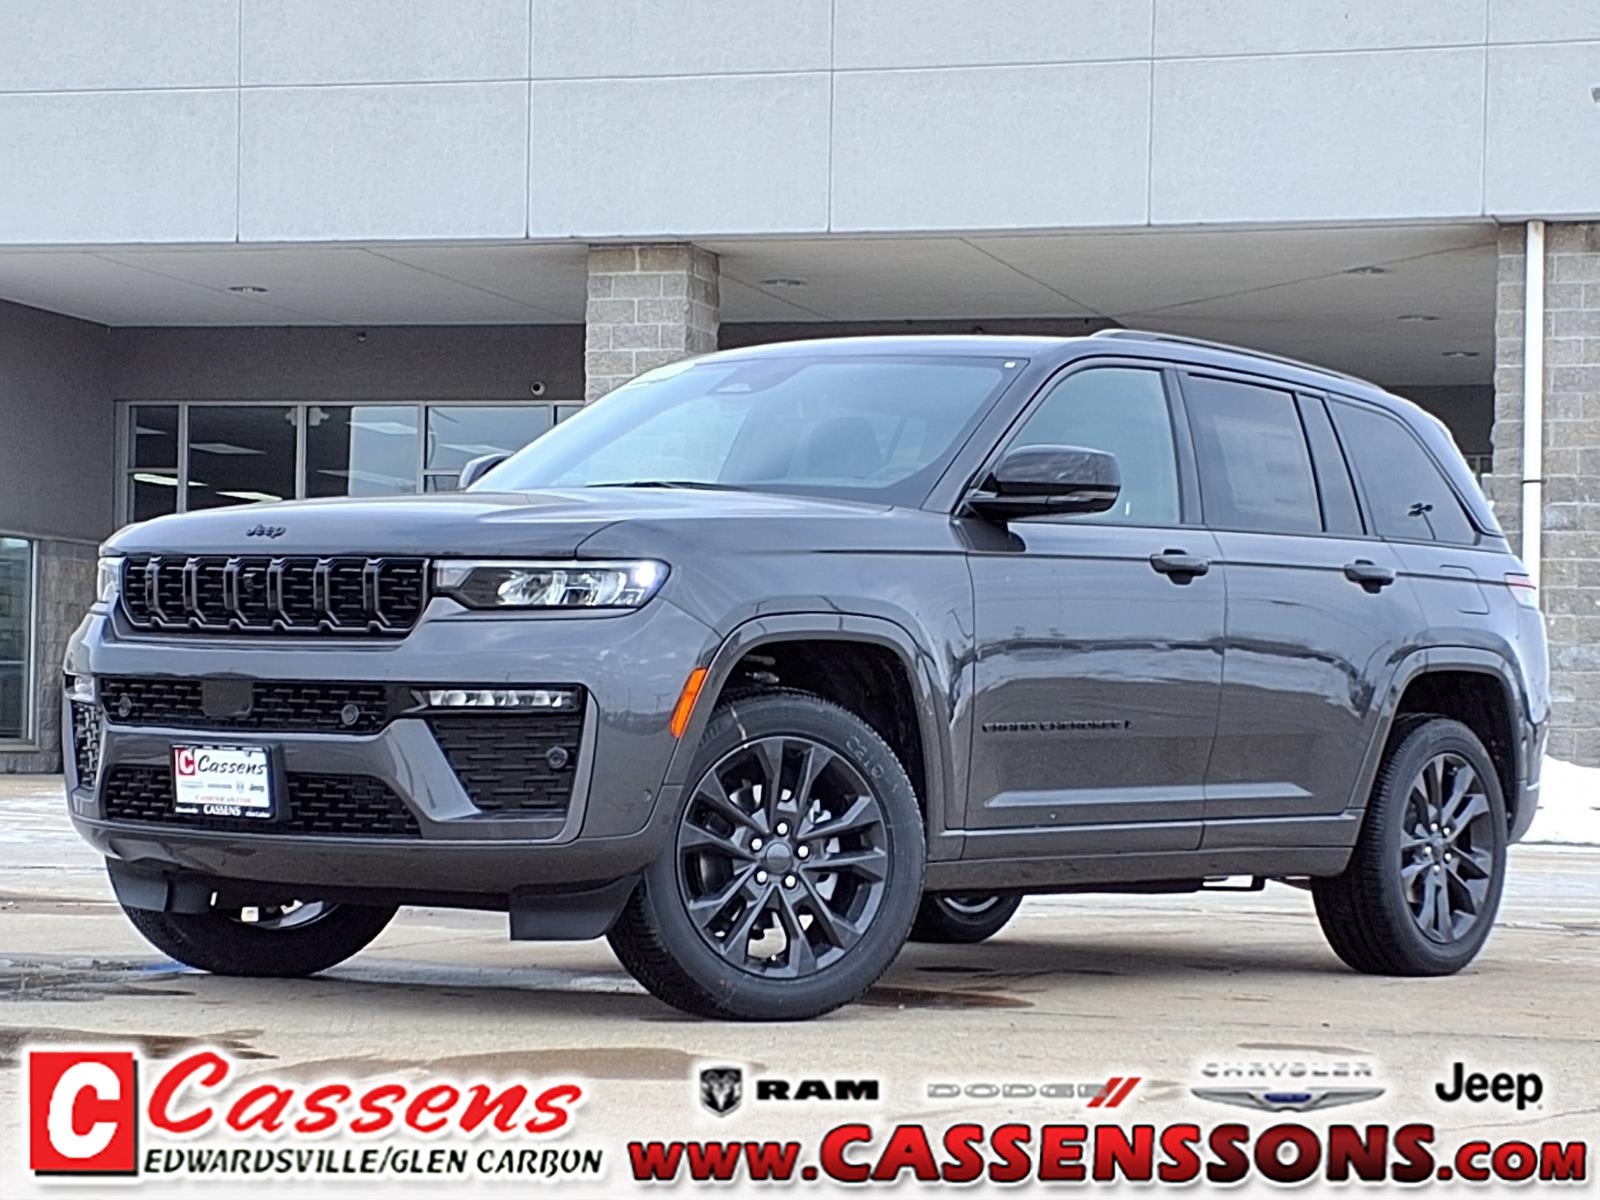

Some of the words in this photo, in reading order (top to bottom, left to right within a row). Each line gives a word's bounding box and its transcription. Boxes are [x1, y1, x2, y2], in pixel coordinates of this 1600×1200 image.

[246, 523, 287, 540] Jeep
[197, 754, 265, 776] Cassens
[203, 804, 242, 816] CASSENS
